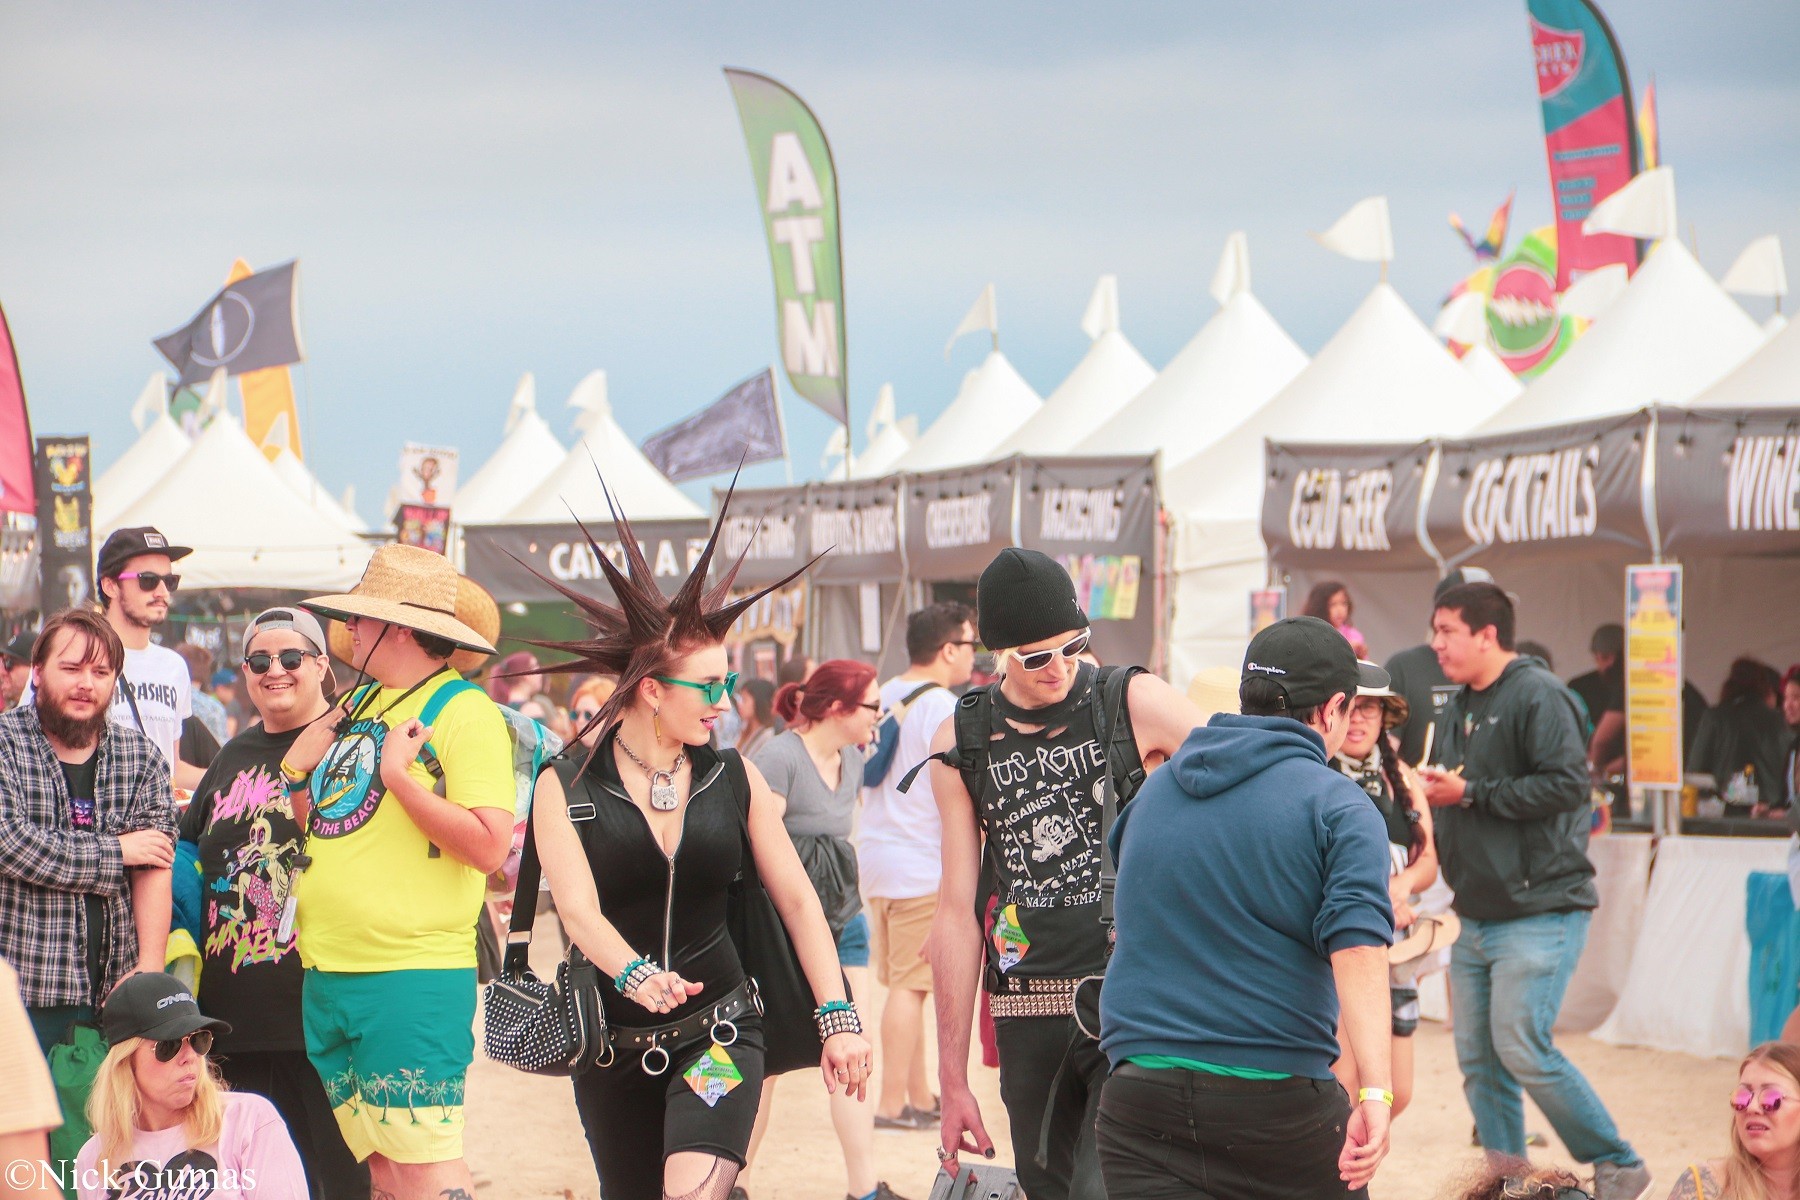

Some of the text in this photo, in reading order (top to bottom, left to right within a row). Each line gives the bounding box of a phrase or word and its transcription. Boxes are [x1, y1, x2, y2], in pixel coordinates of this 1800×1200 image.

[766, 131, 839, 378] ATM
[1289, 468, 1393, 550] COLD BEER
[1463, 445, 1599, 545] COCKTAILS
[654, 540, 680, 577] A
[1247, 662, 1286, 675] Champion
[320, 822, 340, 835] THE
[344, 789, 380, 831] BEACH
[1003, 793, 1057, 828] AGAINST
[1026, 896, 1056, 908] NAZI
